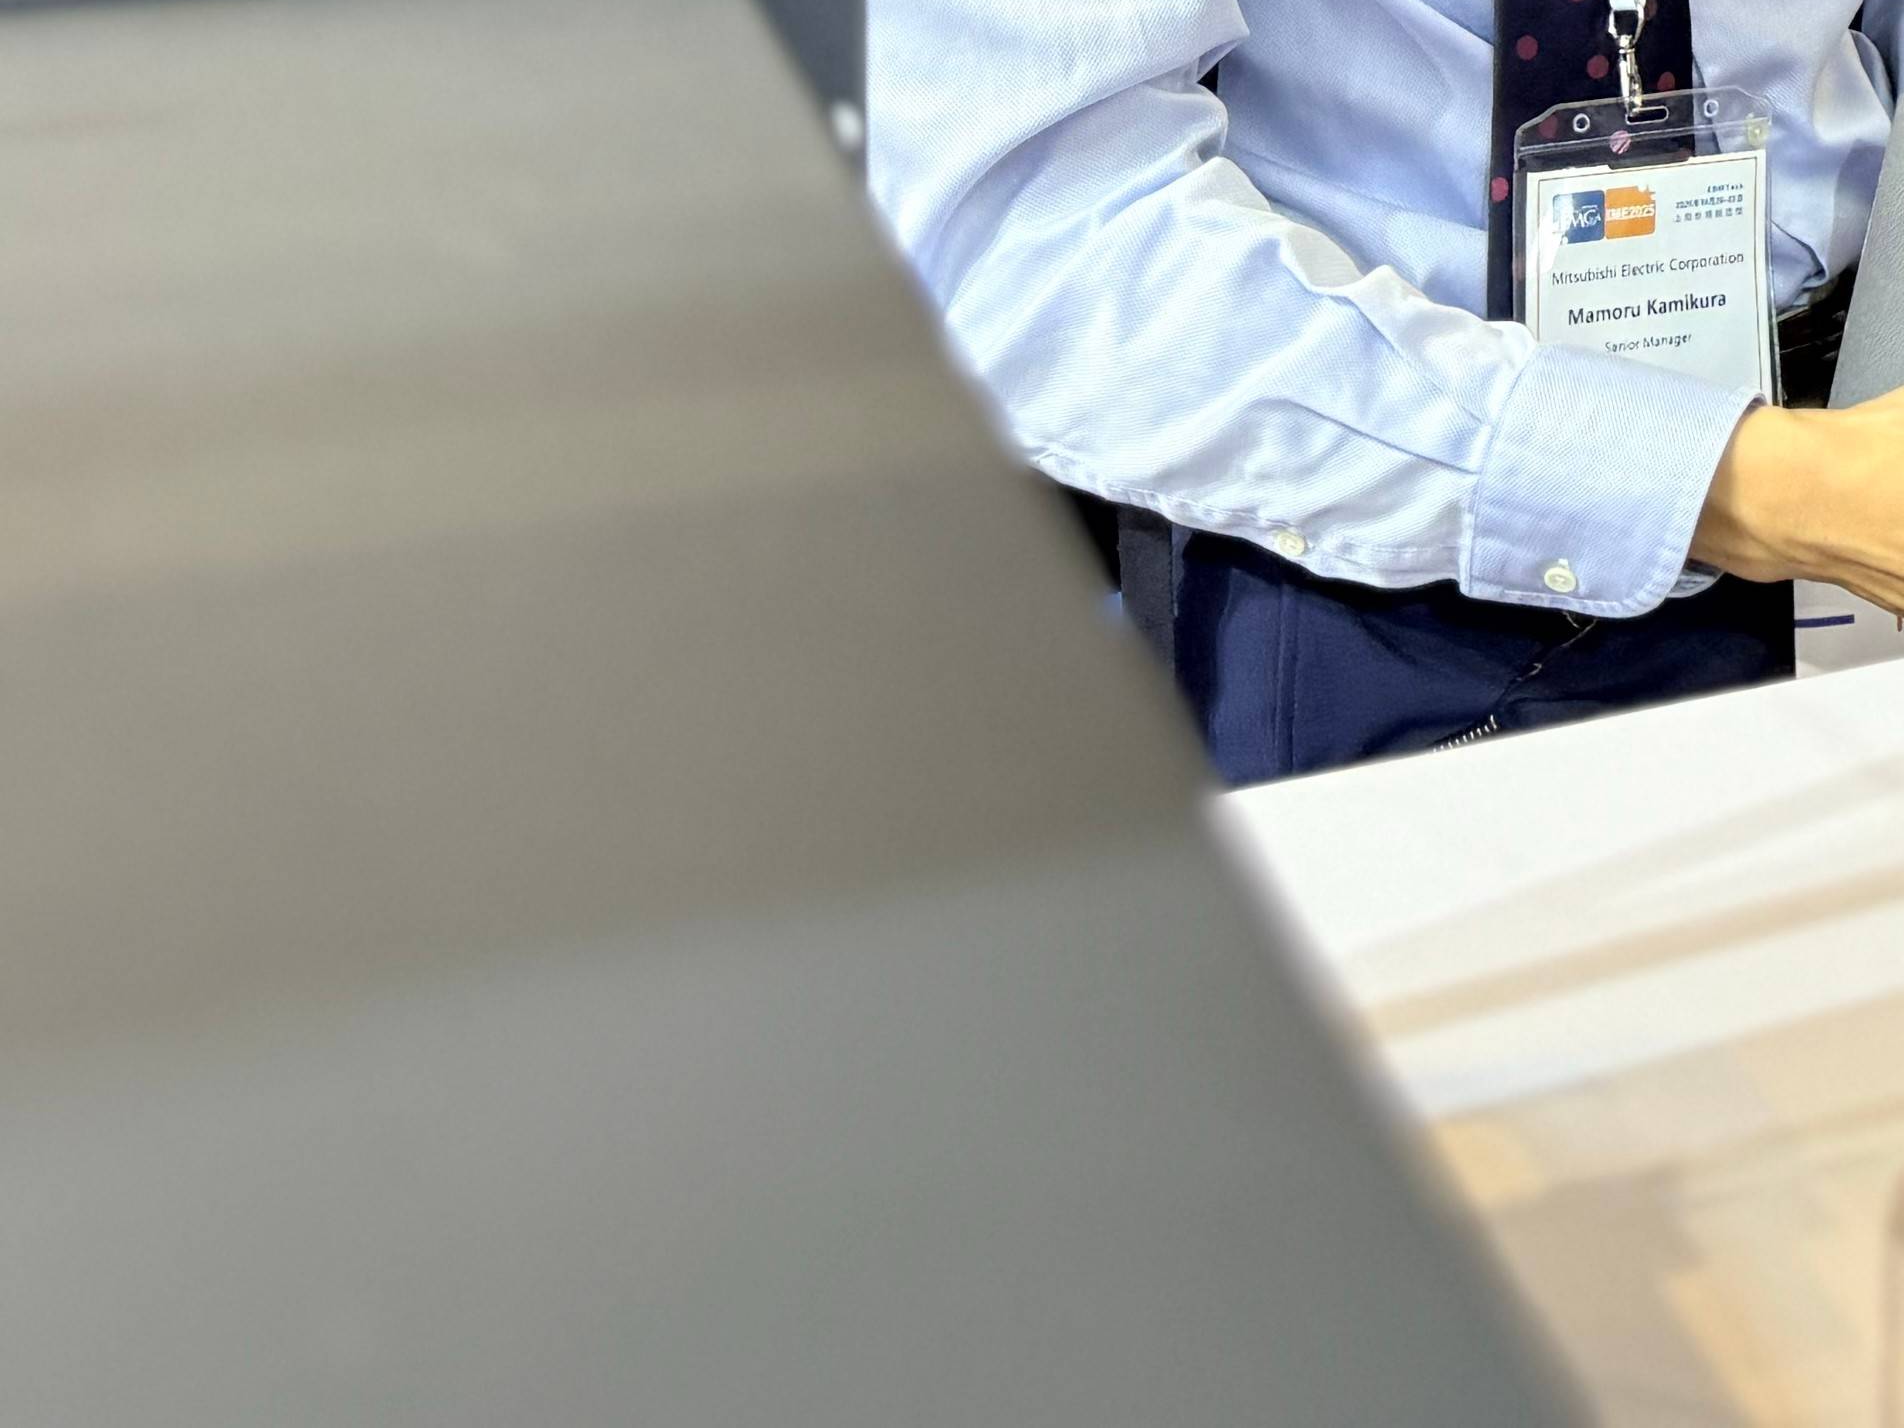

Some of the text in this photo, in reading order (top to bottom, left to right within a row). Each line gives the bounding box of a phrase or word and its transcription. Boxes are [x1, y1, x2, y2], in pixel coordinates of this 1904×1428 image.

[1552, 252, 1745, 286] Mitsubishi Electric Corporation
[1568, 293, 1727, 326] Mamoru Kamikura
[1643, 333, 1692, 349] Manager
